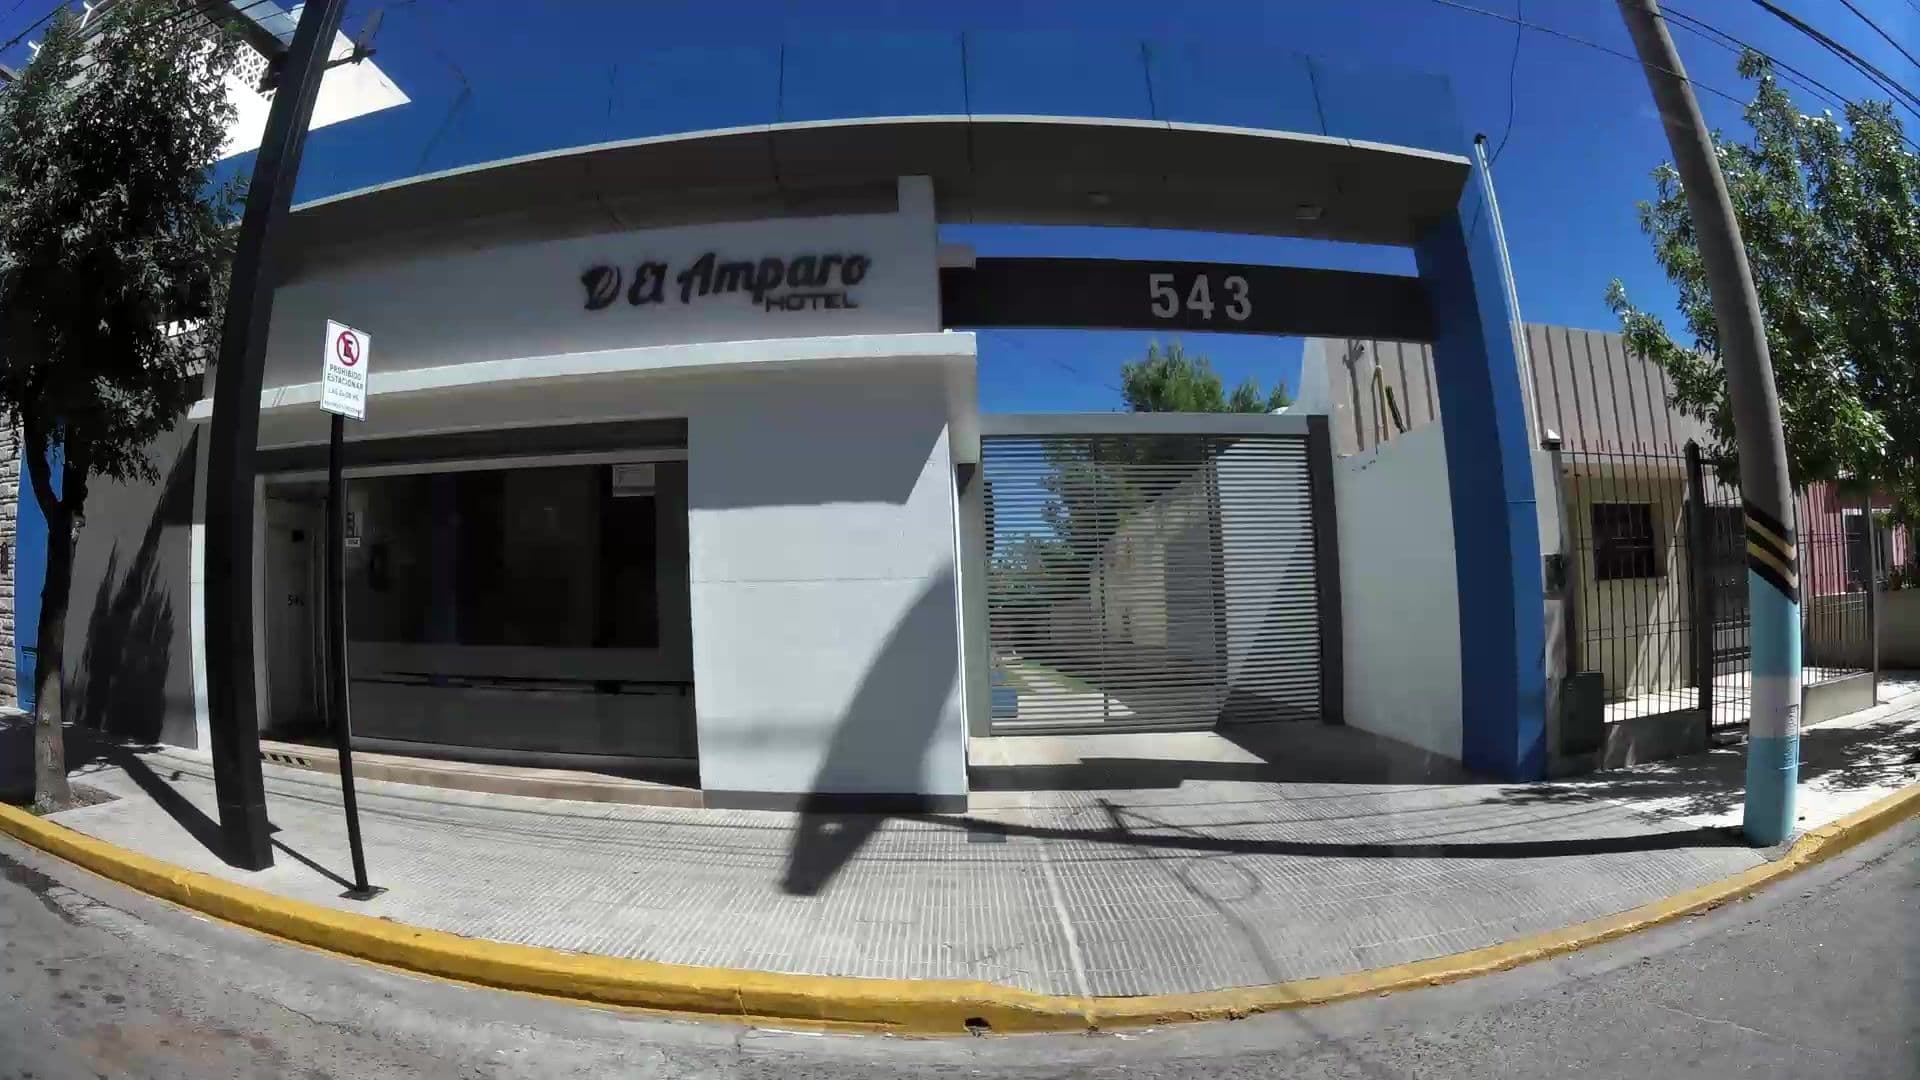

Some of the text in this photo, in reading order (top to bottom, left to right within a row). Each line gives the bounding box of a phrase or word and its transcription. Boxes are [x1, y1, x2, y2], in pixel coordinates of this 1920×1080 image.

[677, 252, 872, 304] Amparo
[765, 291, 859, 313] HOTEL
[1149, 273, 1252, 321] 543
[327, 372, 364, 390] ESTACIONAR
[329, 363, 362, 381] PROHIBIDO
